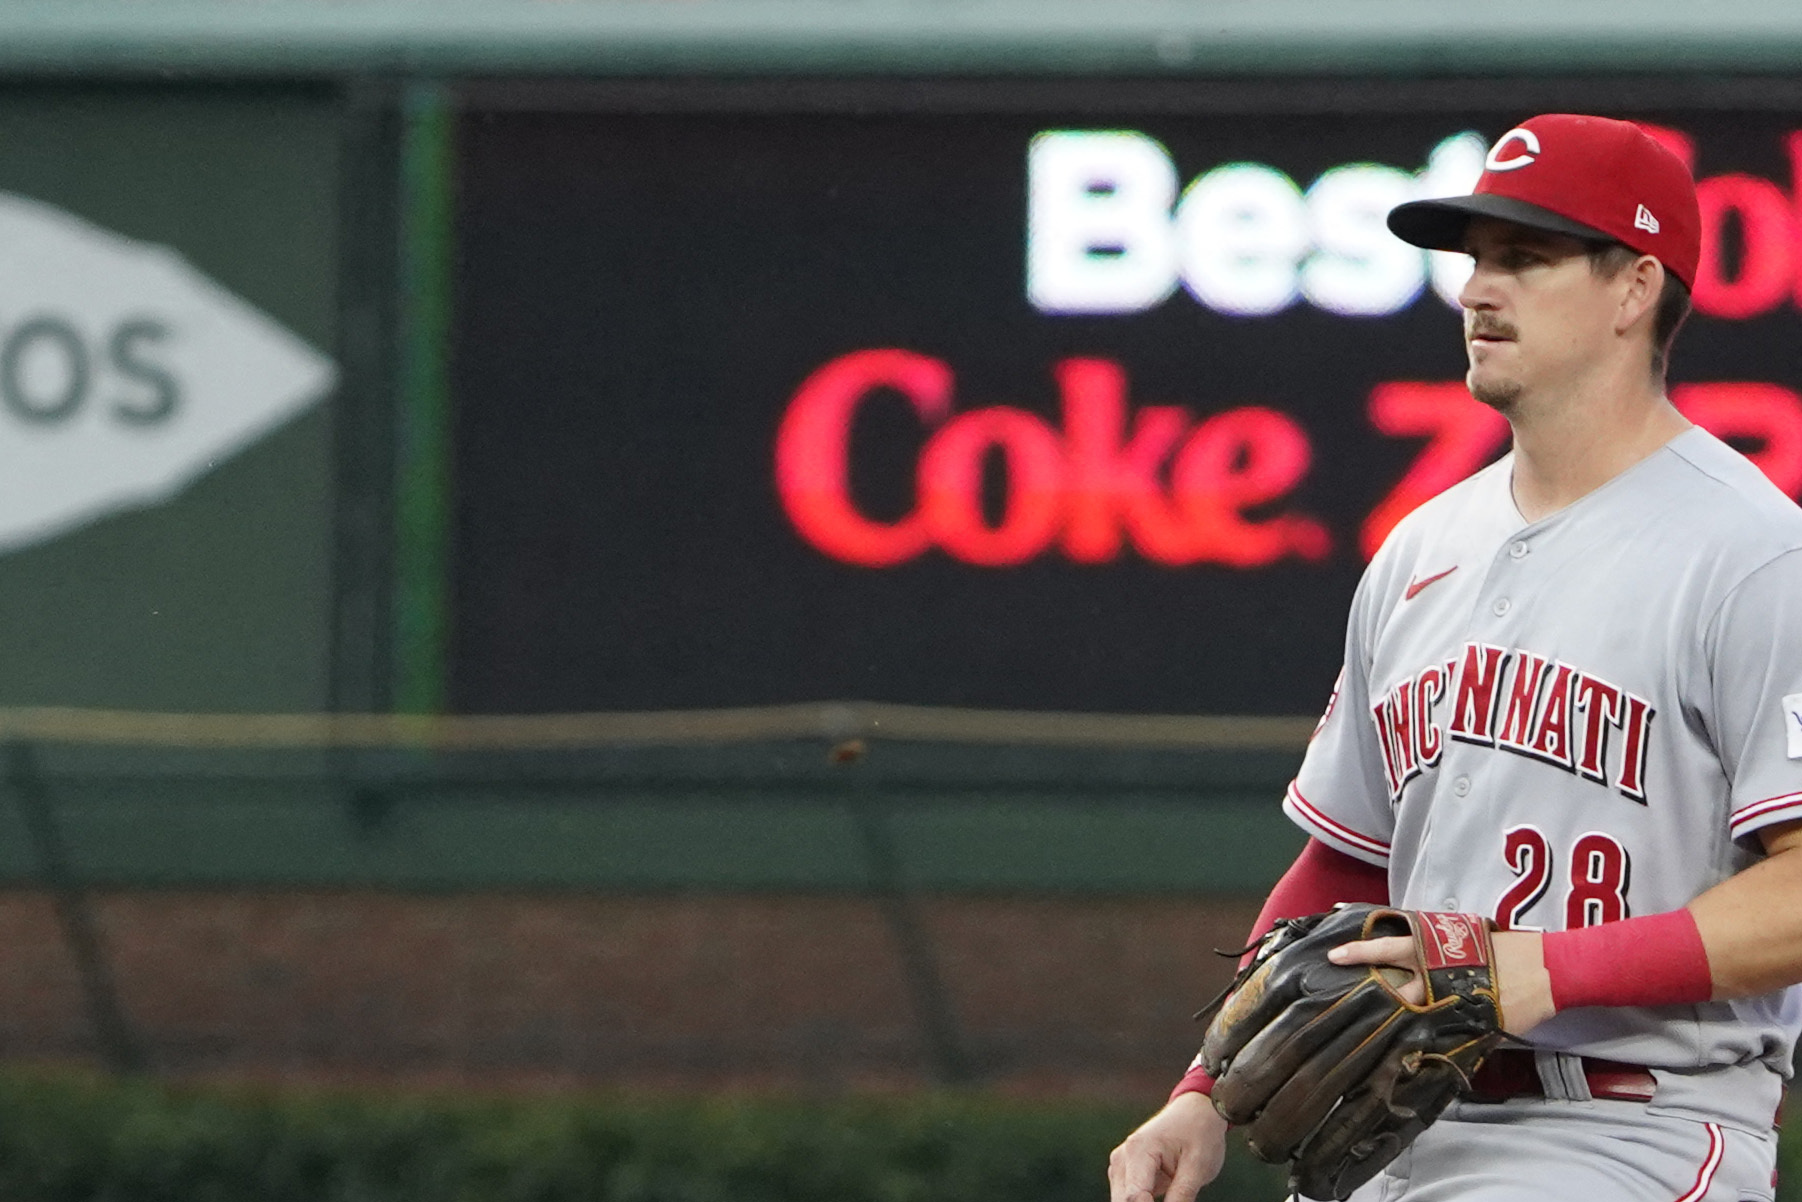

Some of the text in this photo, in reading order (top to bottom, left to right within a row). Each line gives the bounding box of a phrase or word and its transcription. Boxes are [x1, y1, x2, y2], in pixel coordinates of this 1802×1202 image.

[1027, 130, 1488, 315] Best
[1486, 128, 1541, 172] C
[775, 349, 1324, 567] Coke
[1492, 823, 1631, 932] 28
